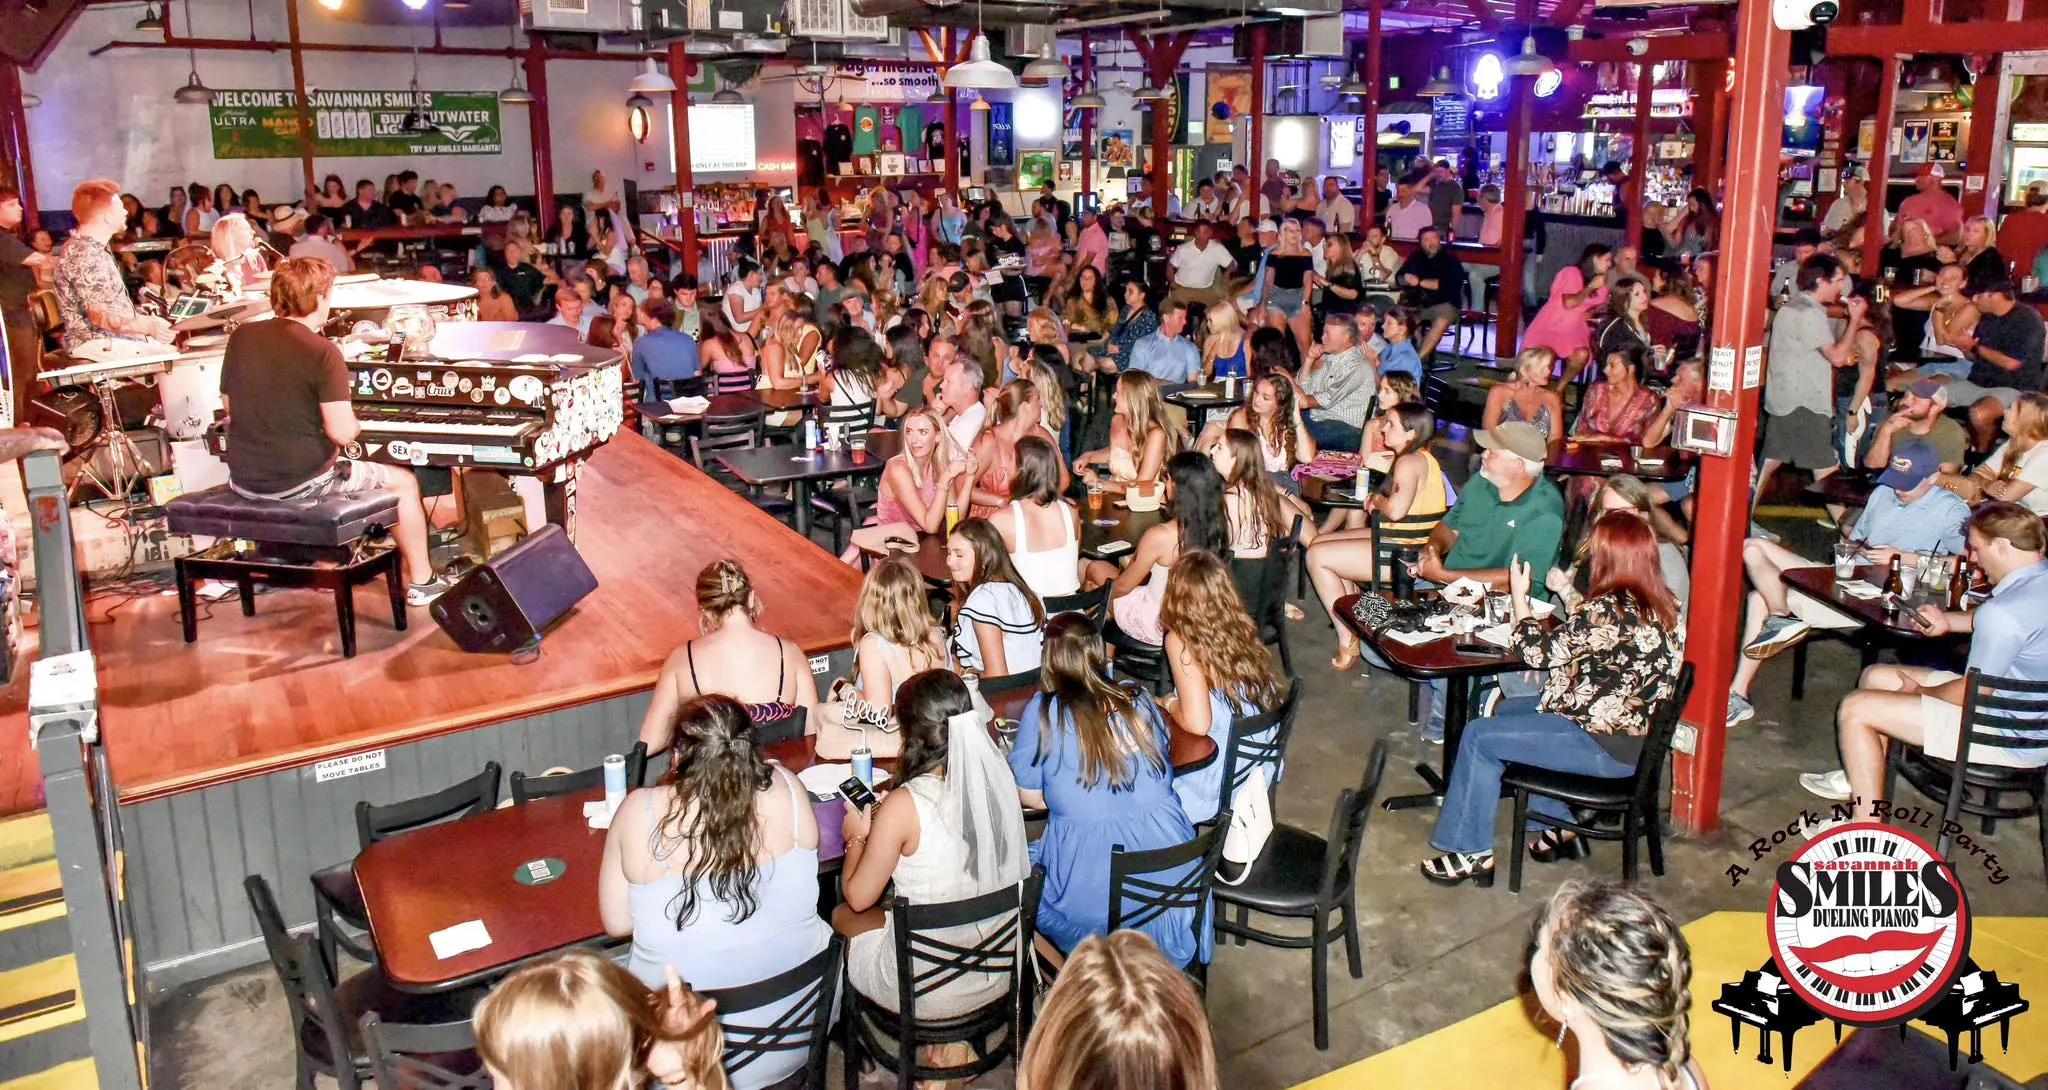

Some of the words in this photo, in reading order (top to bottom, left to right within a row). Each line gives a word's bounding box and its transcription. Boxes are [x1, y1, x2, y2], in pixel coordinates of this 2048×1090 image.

[898, 74, 939, 86] smooth
[212, 91, 283, 107] WELCOME
[285, 92, 298, 107] T
[307, 92, 381, 108] SAVANNAH
[214, 117, 257, 126] ULTRA
[424, 111, 490, 123] UTWATER
[375, 124, 404, 135] LIG
[758, 161, 779, 171] CASH
[1218, 161, 1232, 169] EXIT
[392, 444, 408, 456] SEX
[815, 656, 828, 664] NOT
[317, 758, 349, 769] PLEASE
[351, 755, 363, 763] DO
[365, 751, 382, 760] NOT
[322, 769, 346, 779] MOVE
[348, 762, 380, 774] TABLES
